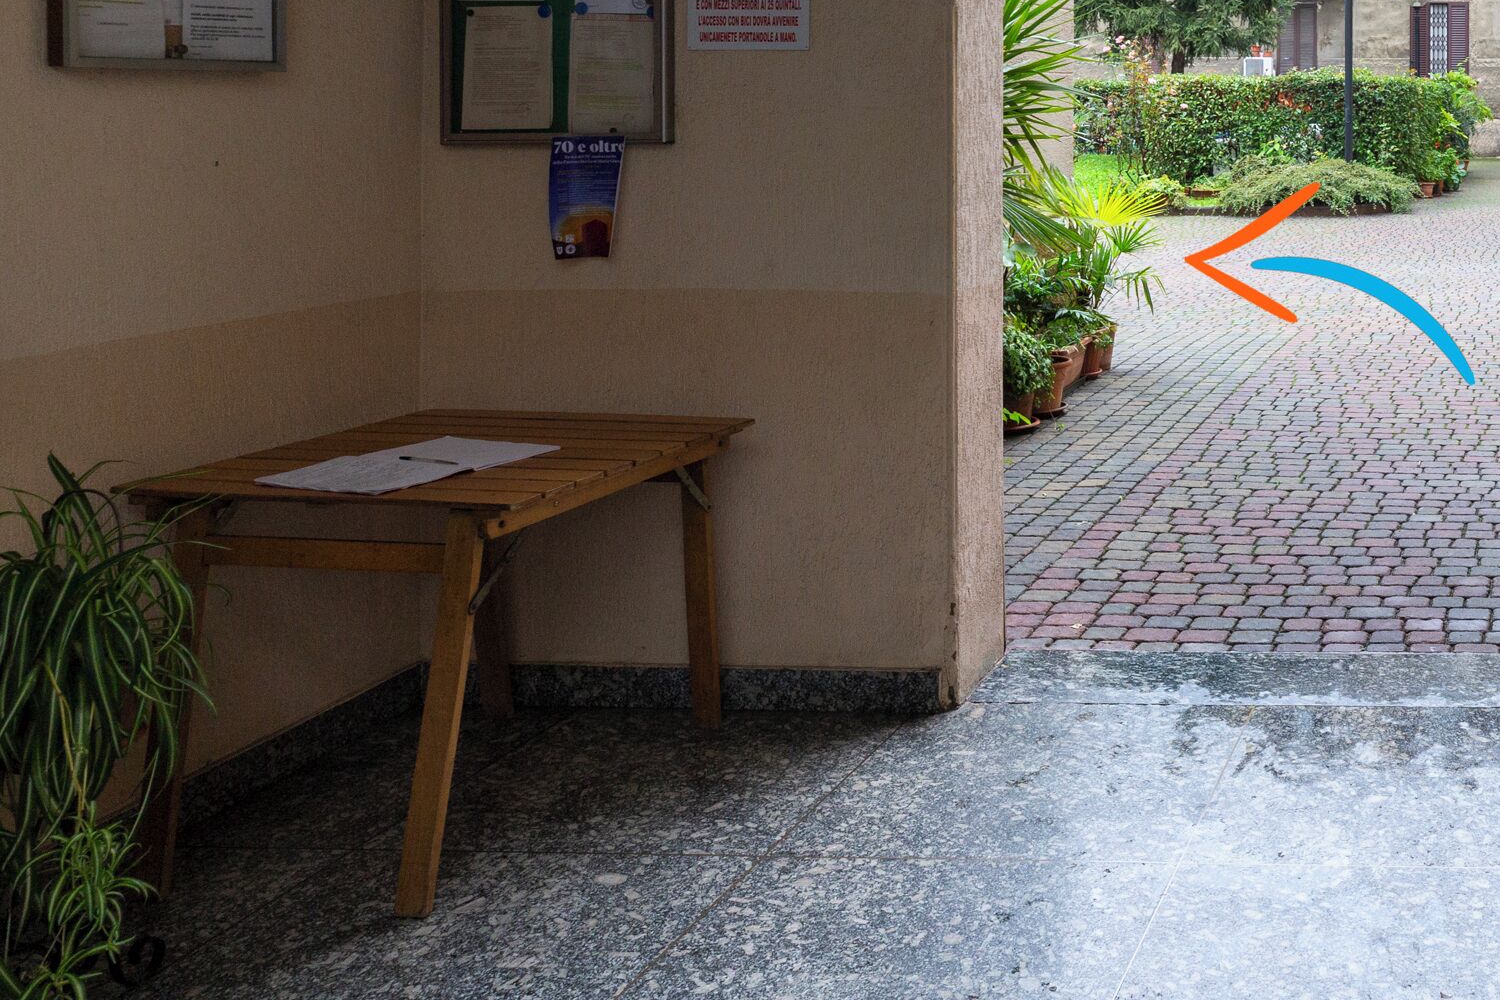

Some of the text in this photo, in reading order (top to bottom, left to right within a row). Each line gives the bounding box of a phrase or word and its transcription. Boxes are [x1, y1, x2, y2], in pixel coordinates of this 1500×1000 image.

[700, 0, 713, 10] CON
[713, 0, 730, 10] MEZZI
[731, 0, 760, 10] SUPERIORI
[760, 0, 767, 10] AI
[728, 15, 740, 26] CON
[740, 15, 752, 26] BICI
[772, 15, 799, 26] AVVENIRE
[738, 31, 774, 42] PORTANDOLE
[553, 140, 574, 154] 70
[577, 143, 586, 153] e
